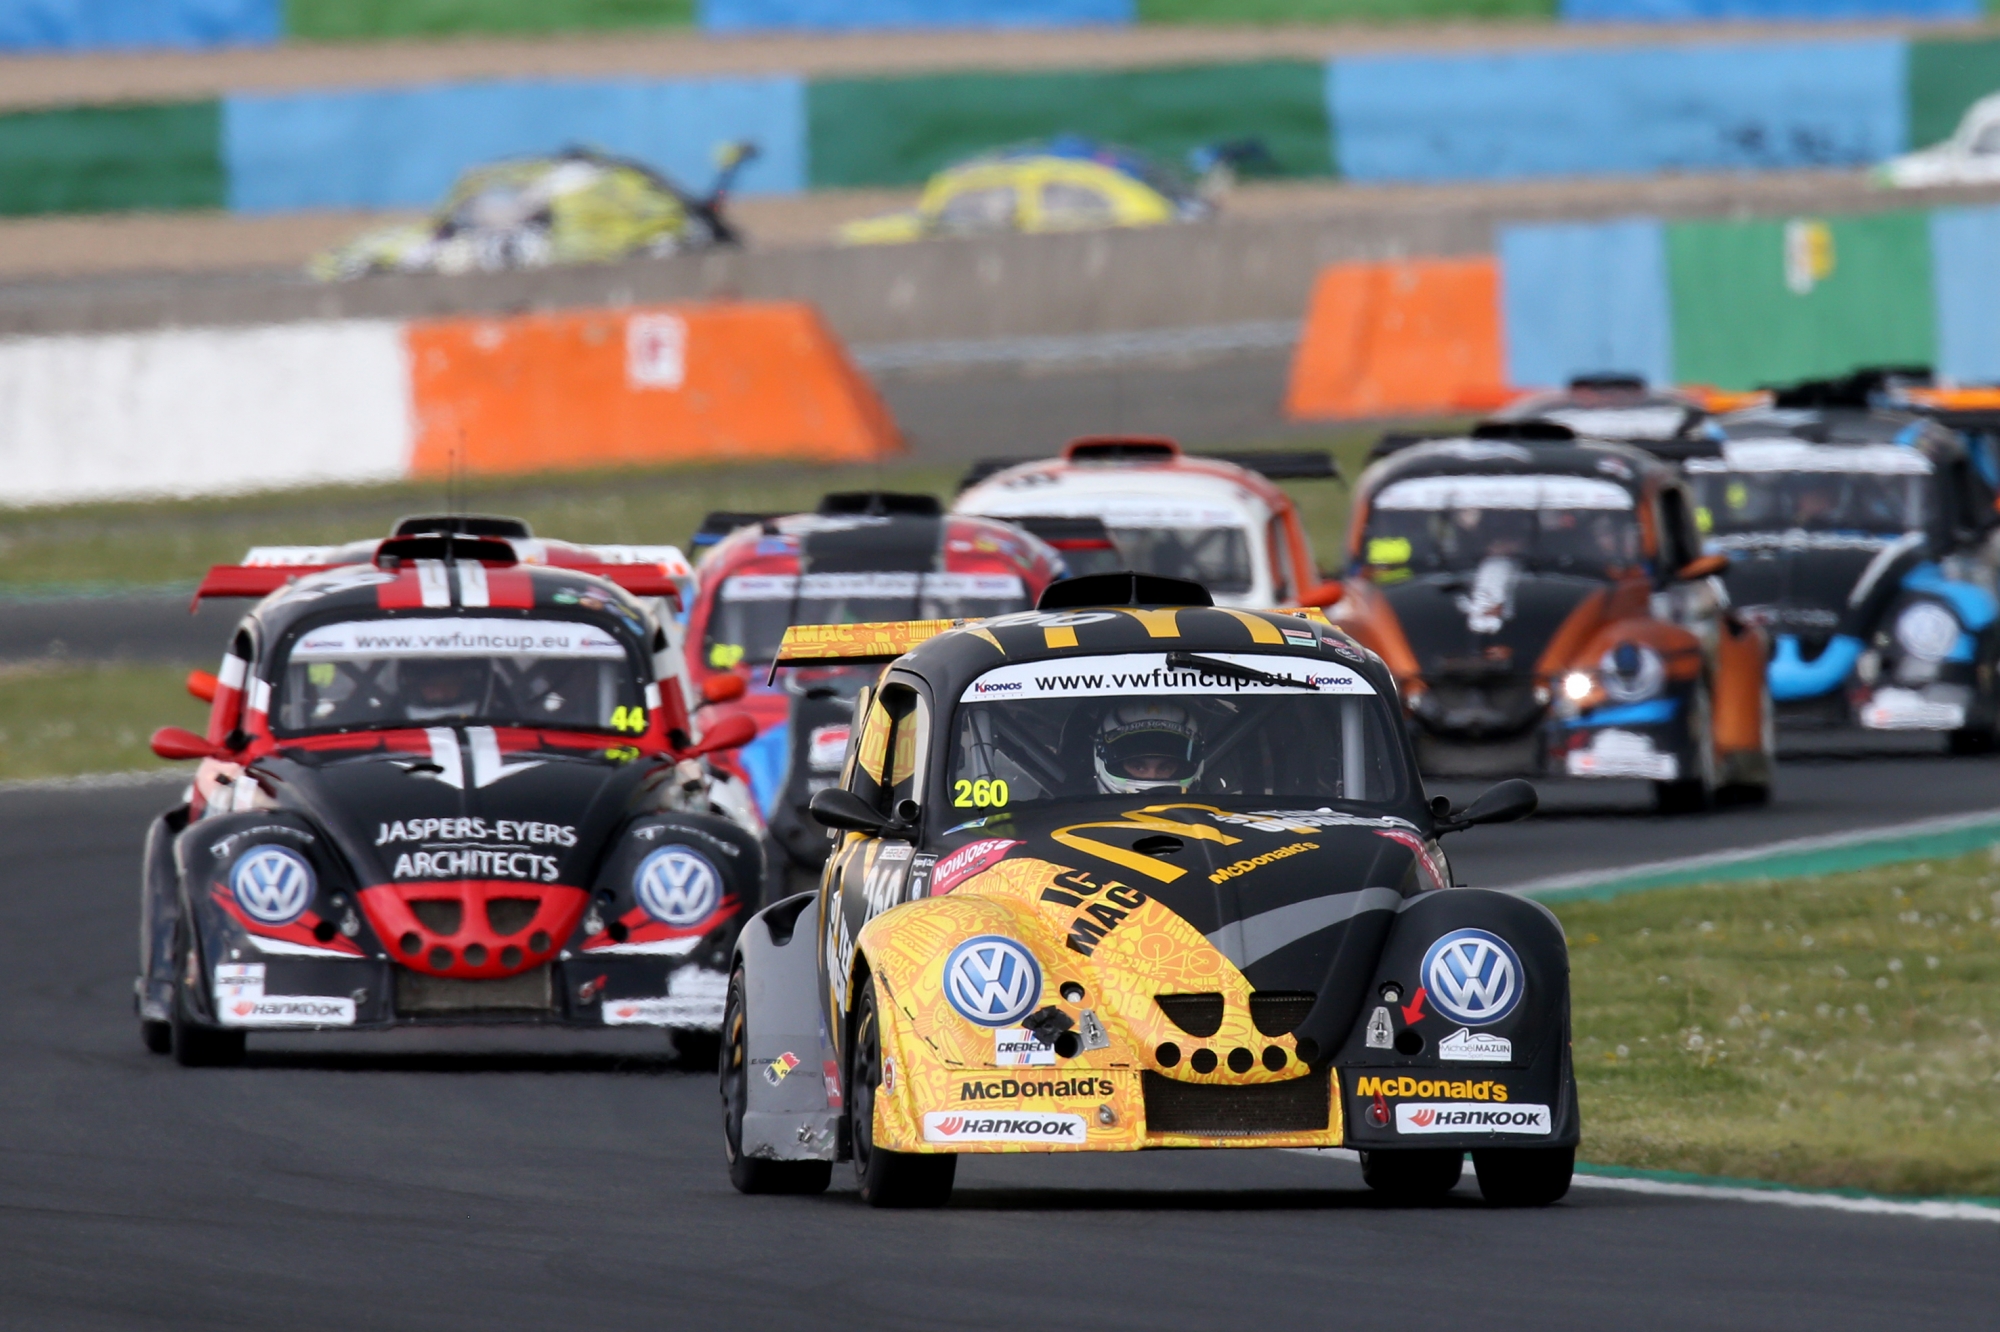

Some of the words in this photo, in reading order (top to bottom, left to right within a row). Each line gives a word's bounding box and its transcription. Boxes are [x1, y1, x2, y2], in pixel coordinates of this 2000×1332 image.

[356, 631, 570, 650] www.vwfuncup.eu
[975, 679, 1022, 693] KRONOS
[1035, 668, 1291, 691] www.vwfuncup.eu
[1306, 673, 1352, 690] KRONOS
[611, 706, 646, 732] 44
[954, 779, 1009, 808] 260
[375, 817, 578, 847] JASPERS-EYERS
[393, 850, 559, 882] ARCHITECTS
[933, 840, 999, 885] NOWJOBS
[1208, 841, 1320, 884] McDonald's
[1066, 885, 1147, 957] MAC
[961, 1078, 1114, 1101] McDonald's
[1357, 1077, 1508, 1102] McDonald's
